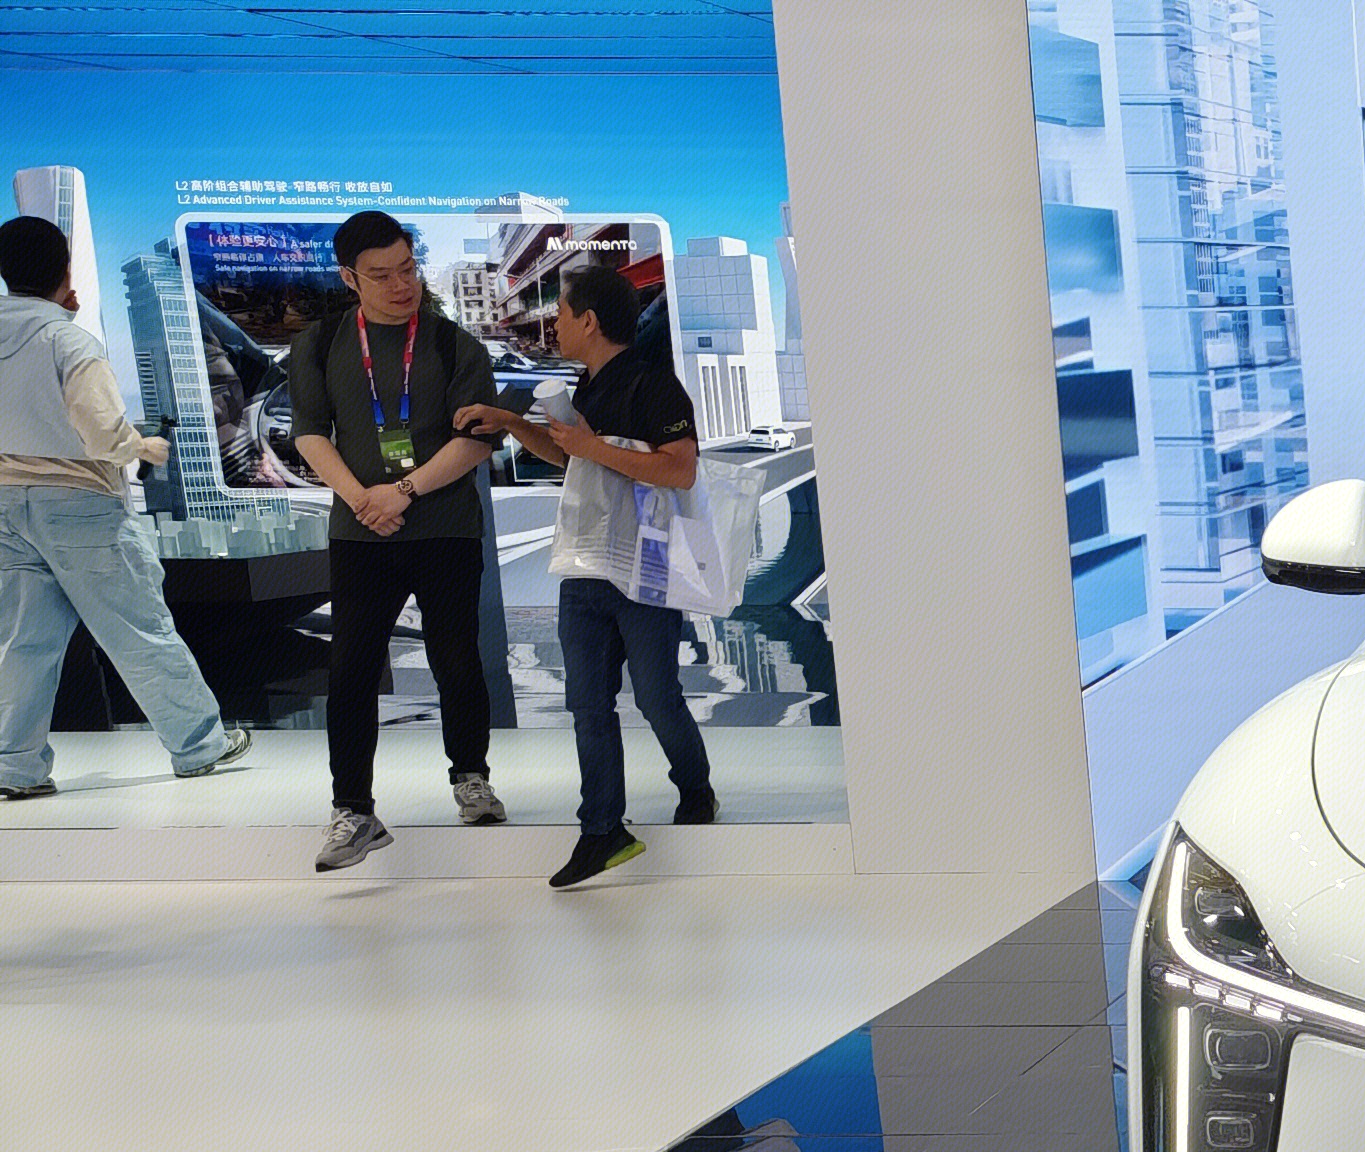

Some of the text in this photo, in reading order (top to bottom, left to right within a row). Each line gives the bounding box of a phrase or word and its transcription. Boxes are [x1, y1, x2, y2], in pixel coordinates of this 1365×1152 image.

[175, 181, 190, 191] L2
[345, 181, 393, 193] 收放自如
[177, 194, 191, 204] L2
[193, 195, 242, 205] Advanced
[244, 195, 275, 205] Driver
[279, 195, 334, 206] Assistance
[429, 196, 482, 208] Navigation
[484, 198, 497, 206] on
[499, 196, 536, 206] Narr
[538, 196, 570, 206] Roads
[565, 240, 637, 250] momenta
